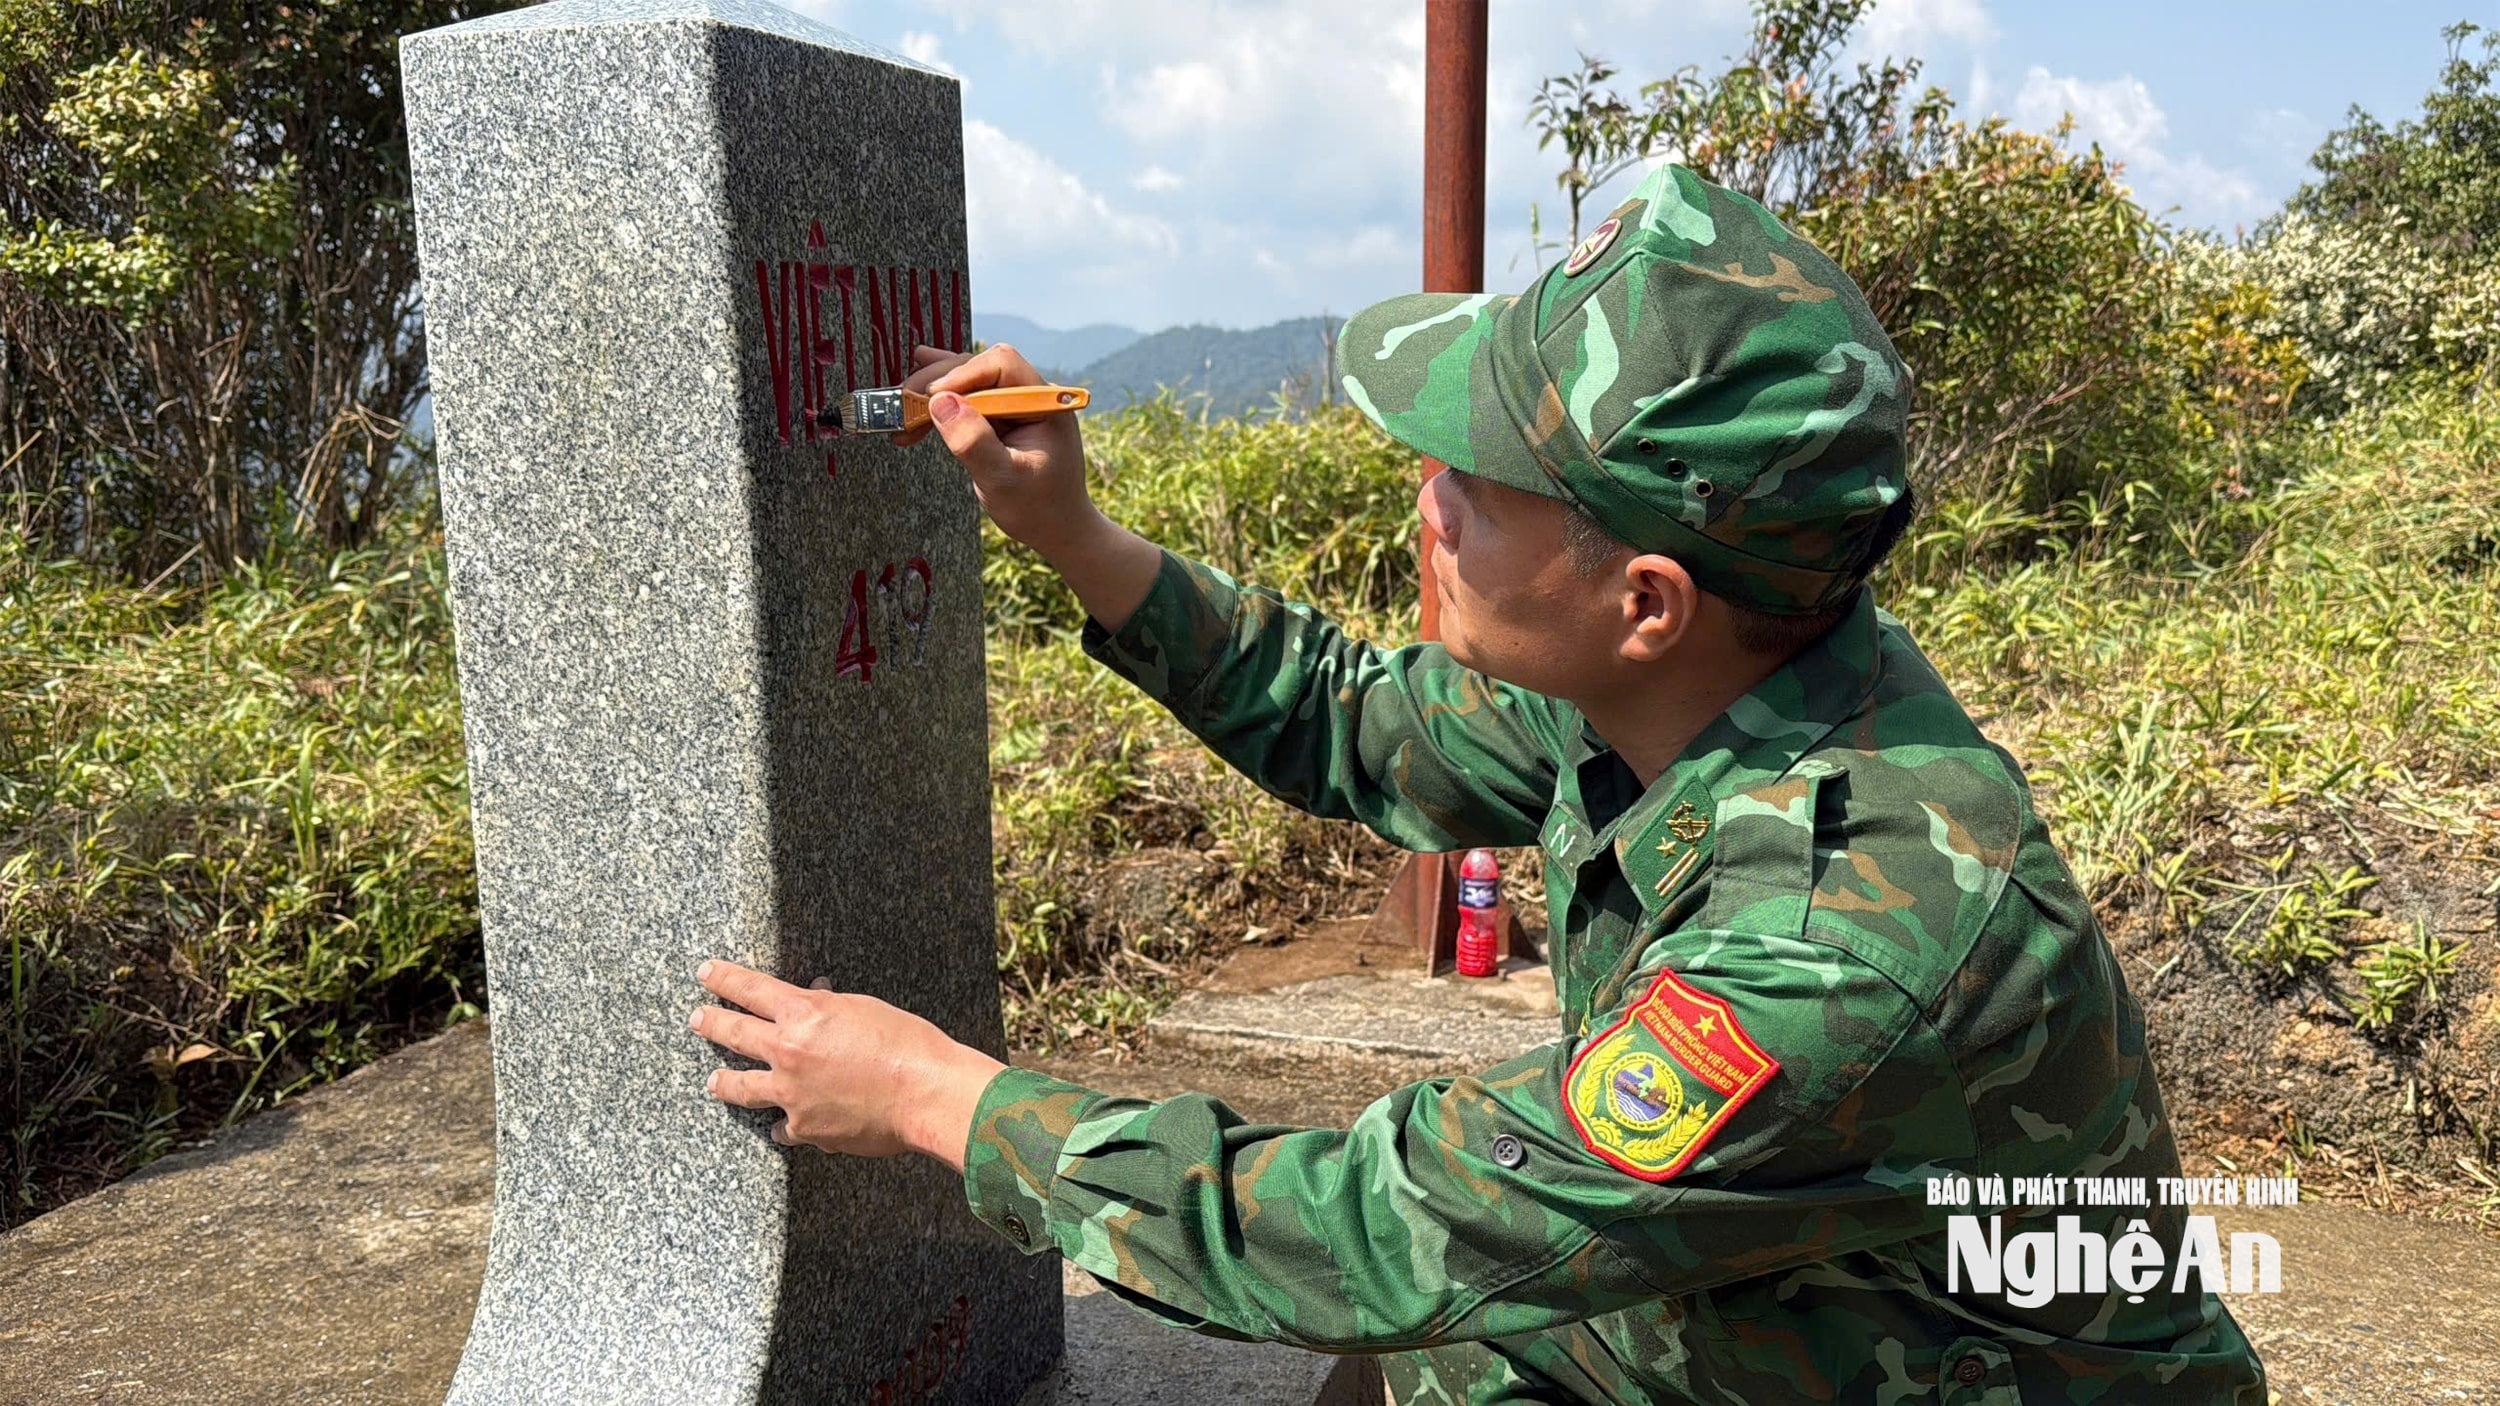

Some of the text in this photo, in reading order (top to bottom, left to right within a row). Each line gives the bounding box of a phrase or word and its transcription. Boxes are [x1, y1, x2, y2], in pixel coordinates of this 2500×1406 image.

[835, 555, 933, 685] 419
[1669, 1036, 1703, 1069] BORDER
[1699, 1063, 1734, 1090] GUARD
[1680, 1028, 1710, 1056] PHÒNG
[1722, 1064, 1750, 1085] NAM
